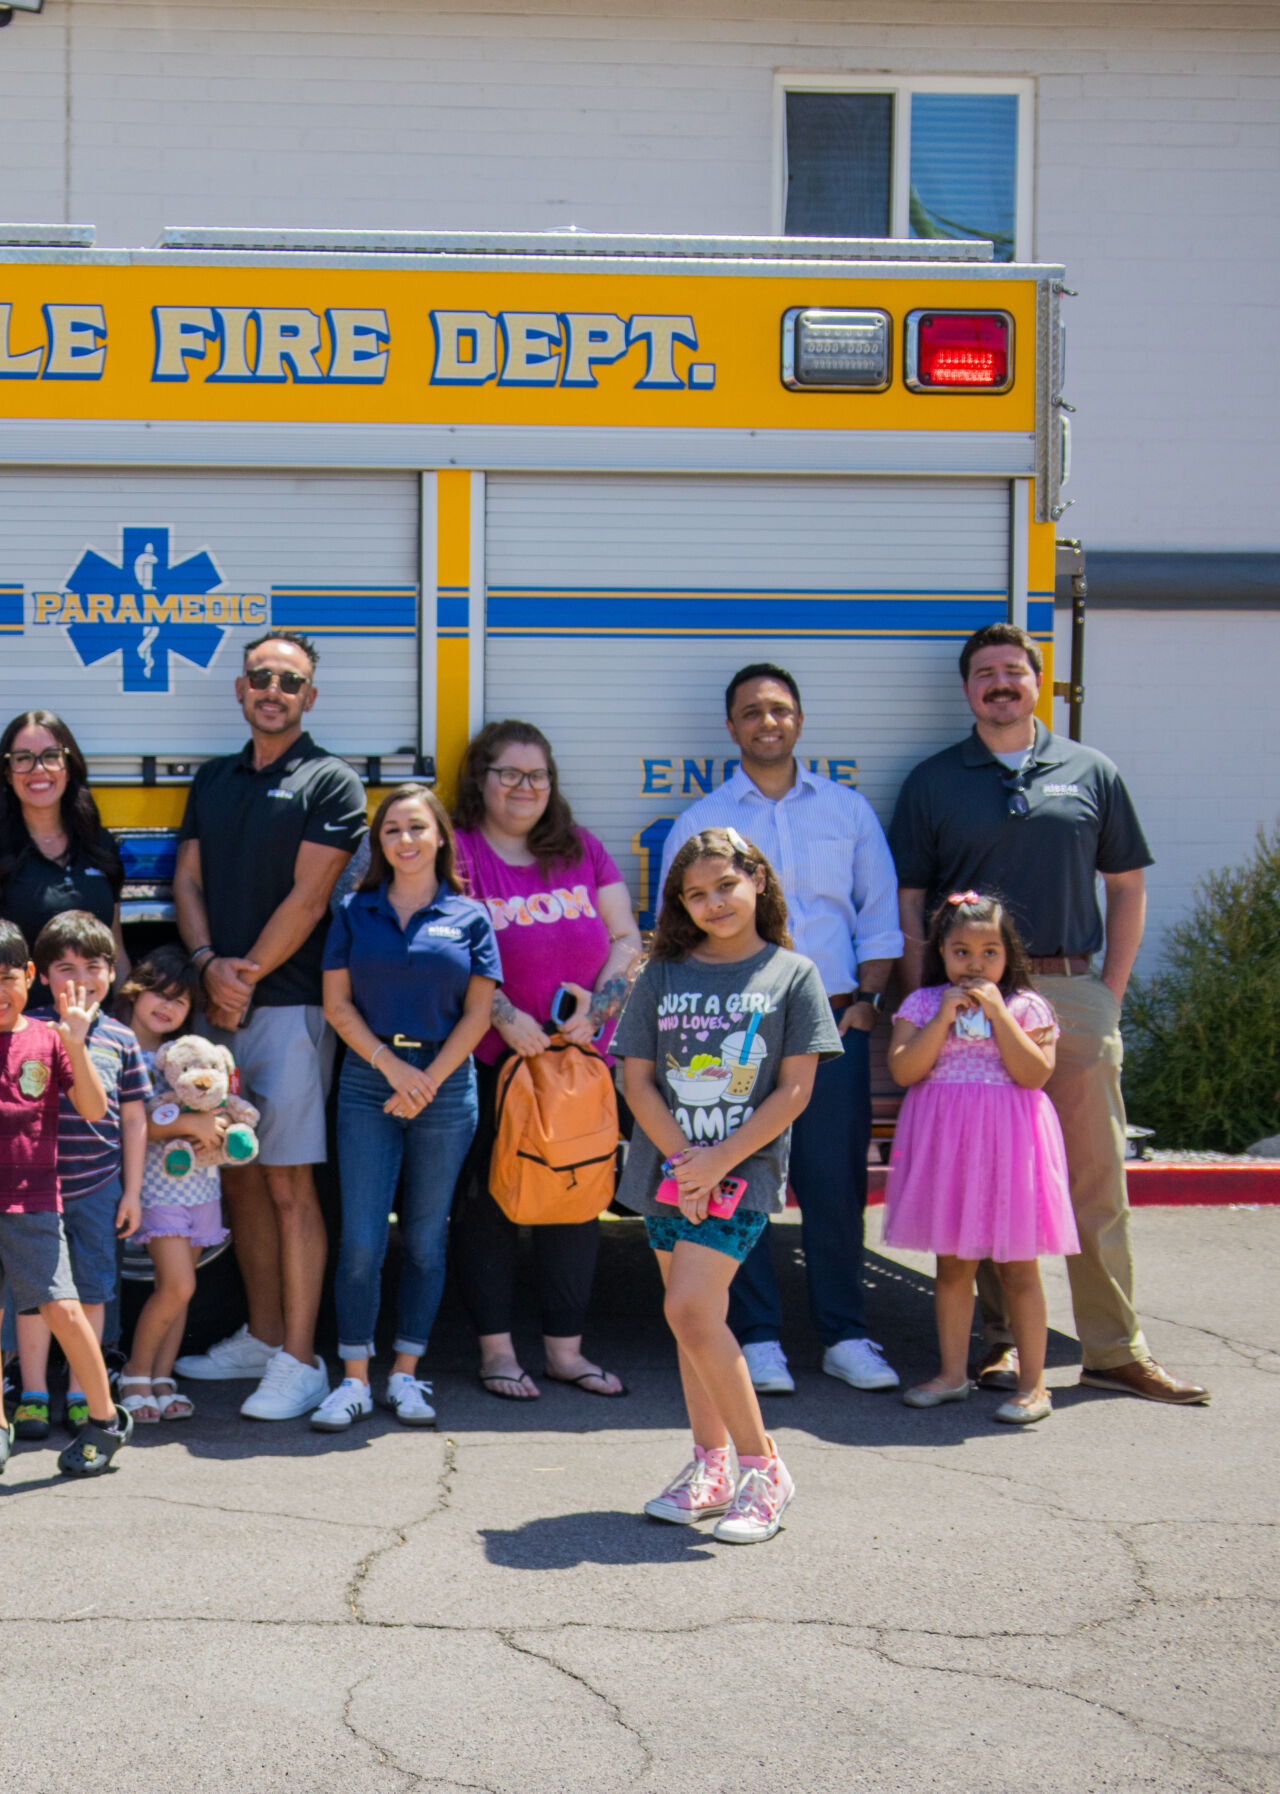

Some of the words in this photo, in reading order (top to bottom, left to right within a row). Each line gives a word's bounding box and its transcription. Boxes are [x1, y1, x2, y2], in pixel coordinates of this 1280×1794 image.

[150, 305, 390, 384] FIRE
[428, 310, 715, 390] DEPT.
[32, 592, 268, 626] PARAMEDIC
[486, 885, 596, 930] MOM
[657, 992, 702, 1016] JUST
[704, 994, 720, 1015] A
[725, 992, 778, 1014] GIRL
[682, 1014, 724, 1030] LOVES
